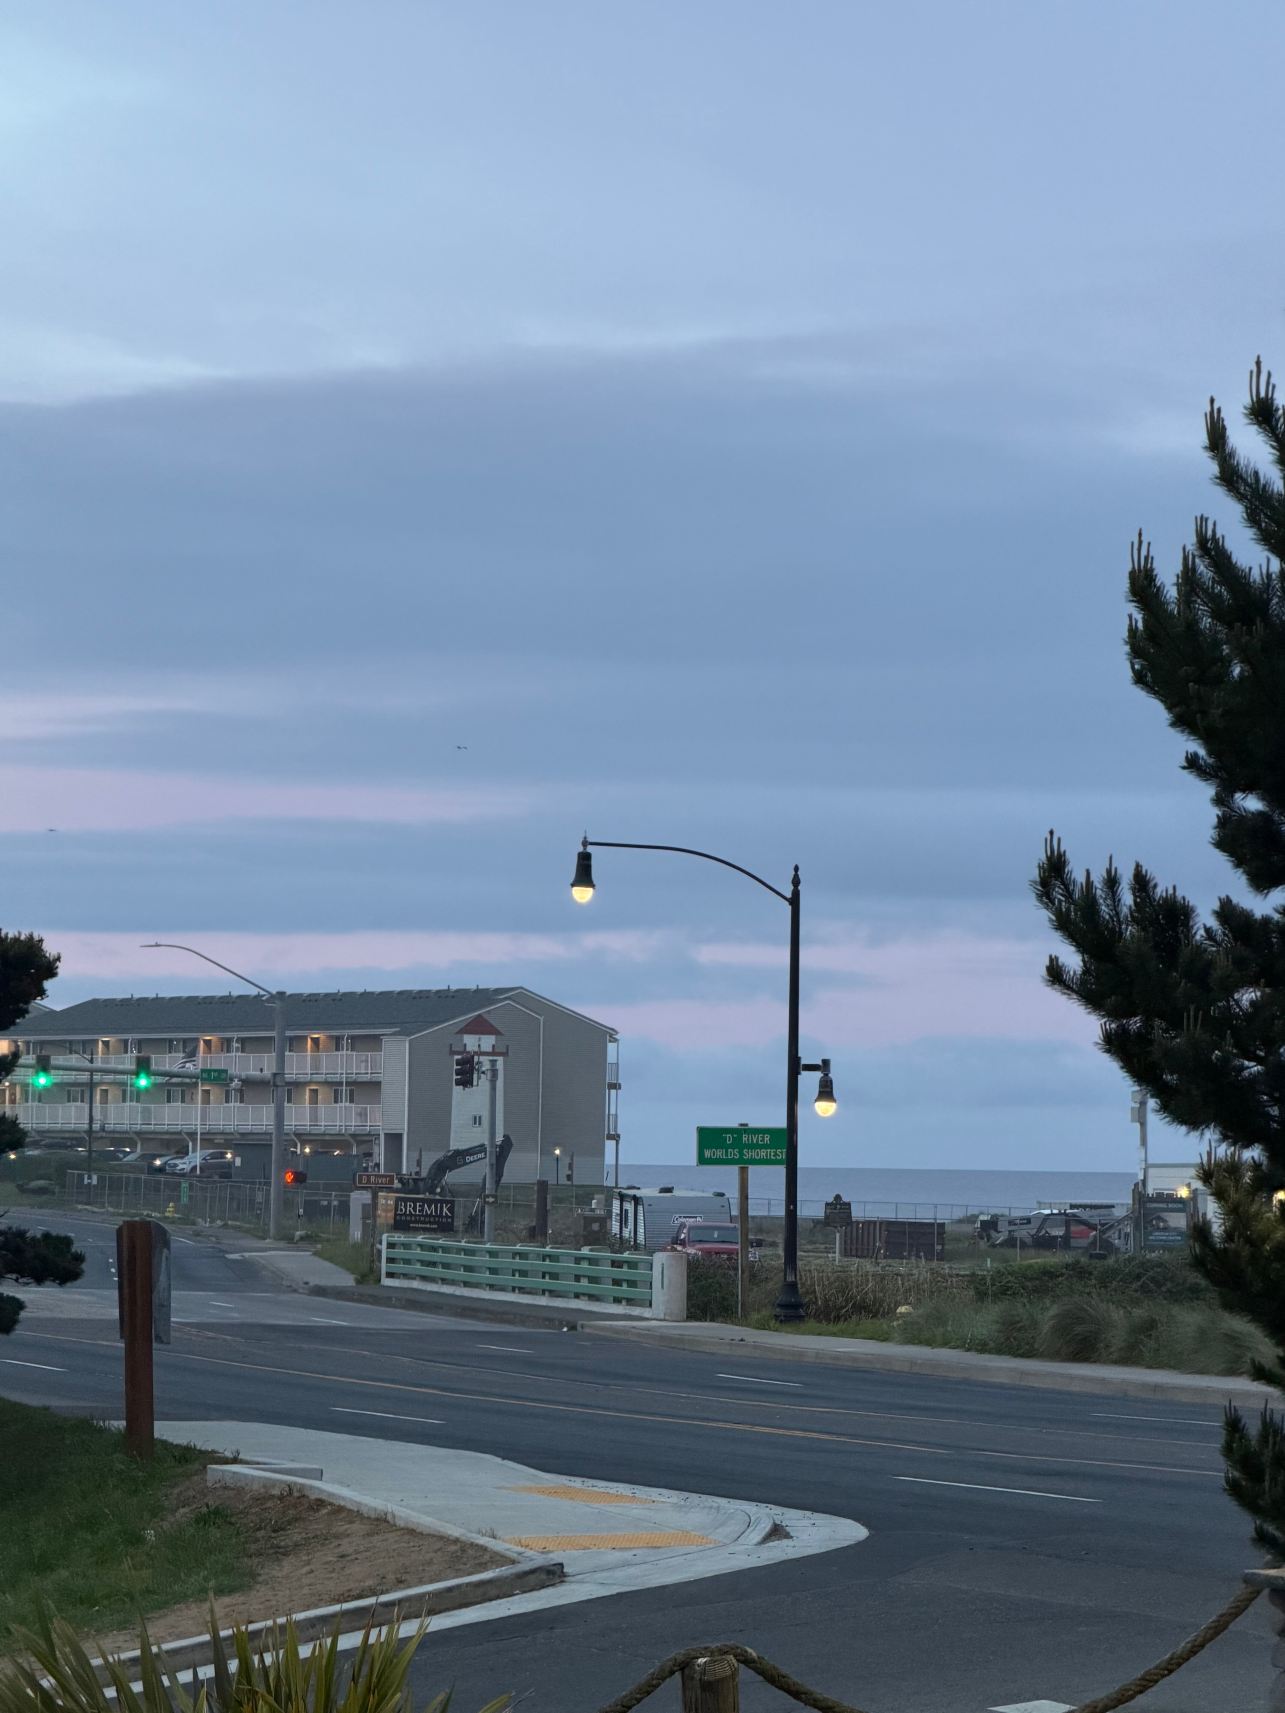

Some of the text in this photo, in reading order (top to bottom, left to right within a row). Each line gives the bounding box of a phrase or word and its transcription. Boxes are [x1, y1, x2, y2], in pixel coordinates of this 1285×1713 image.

[742, 1133, 770, 1144] RIVER
[465, 1152, 485, 1162] DEERE
[704, 1148, 739, 1159] WORLDS
[370, 1175, 390, 1185] River
[397, 1201, 452, 1217] BREMIK
